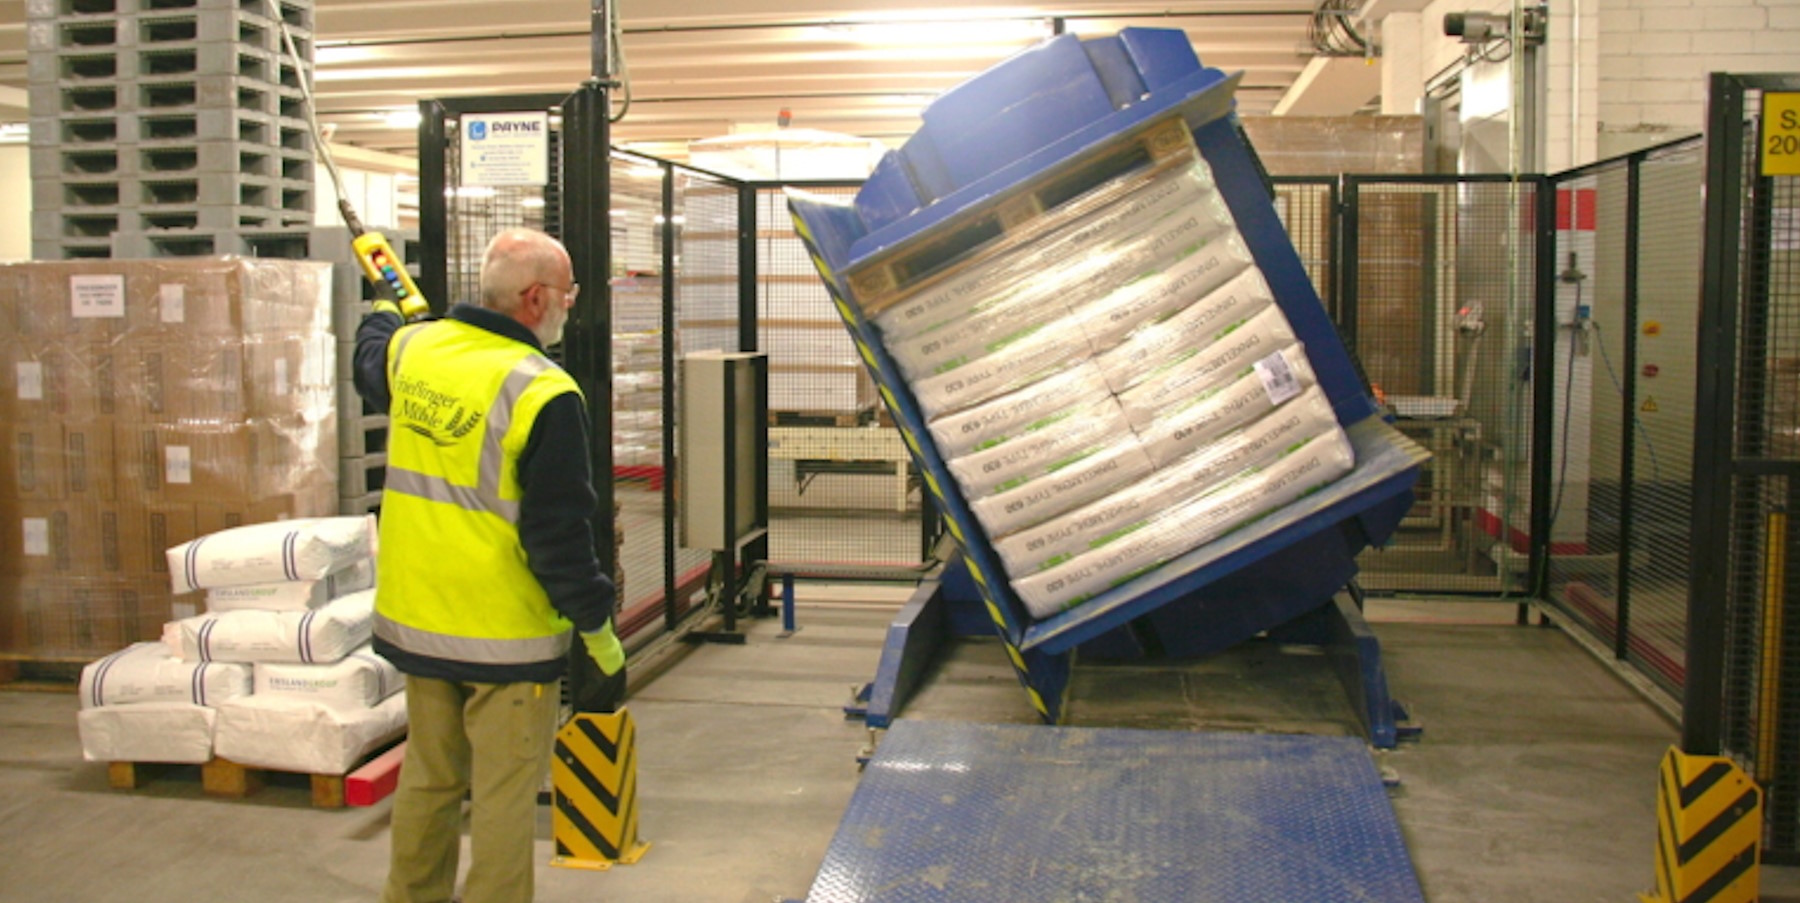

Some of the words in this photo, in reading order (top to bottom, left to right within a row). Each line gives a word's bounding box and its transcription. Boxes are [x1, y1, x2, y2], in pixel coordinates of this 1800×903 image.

[492, 121, 541, 132] PAYNE
[1780, 109, 1800, 131] S
[1769, 134, 1800, 155] 20
